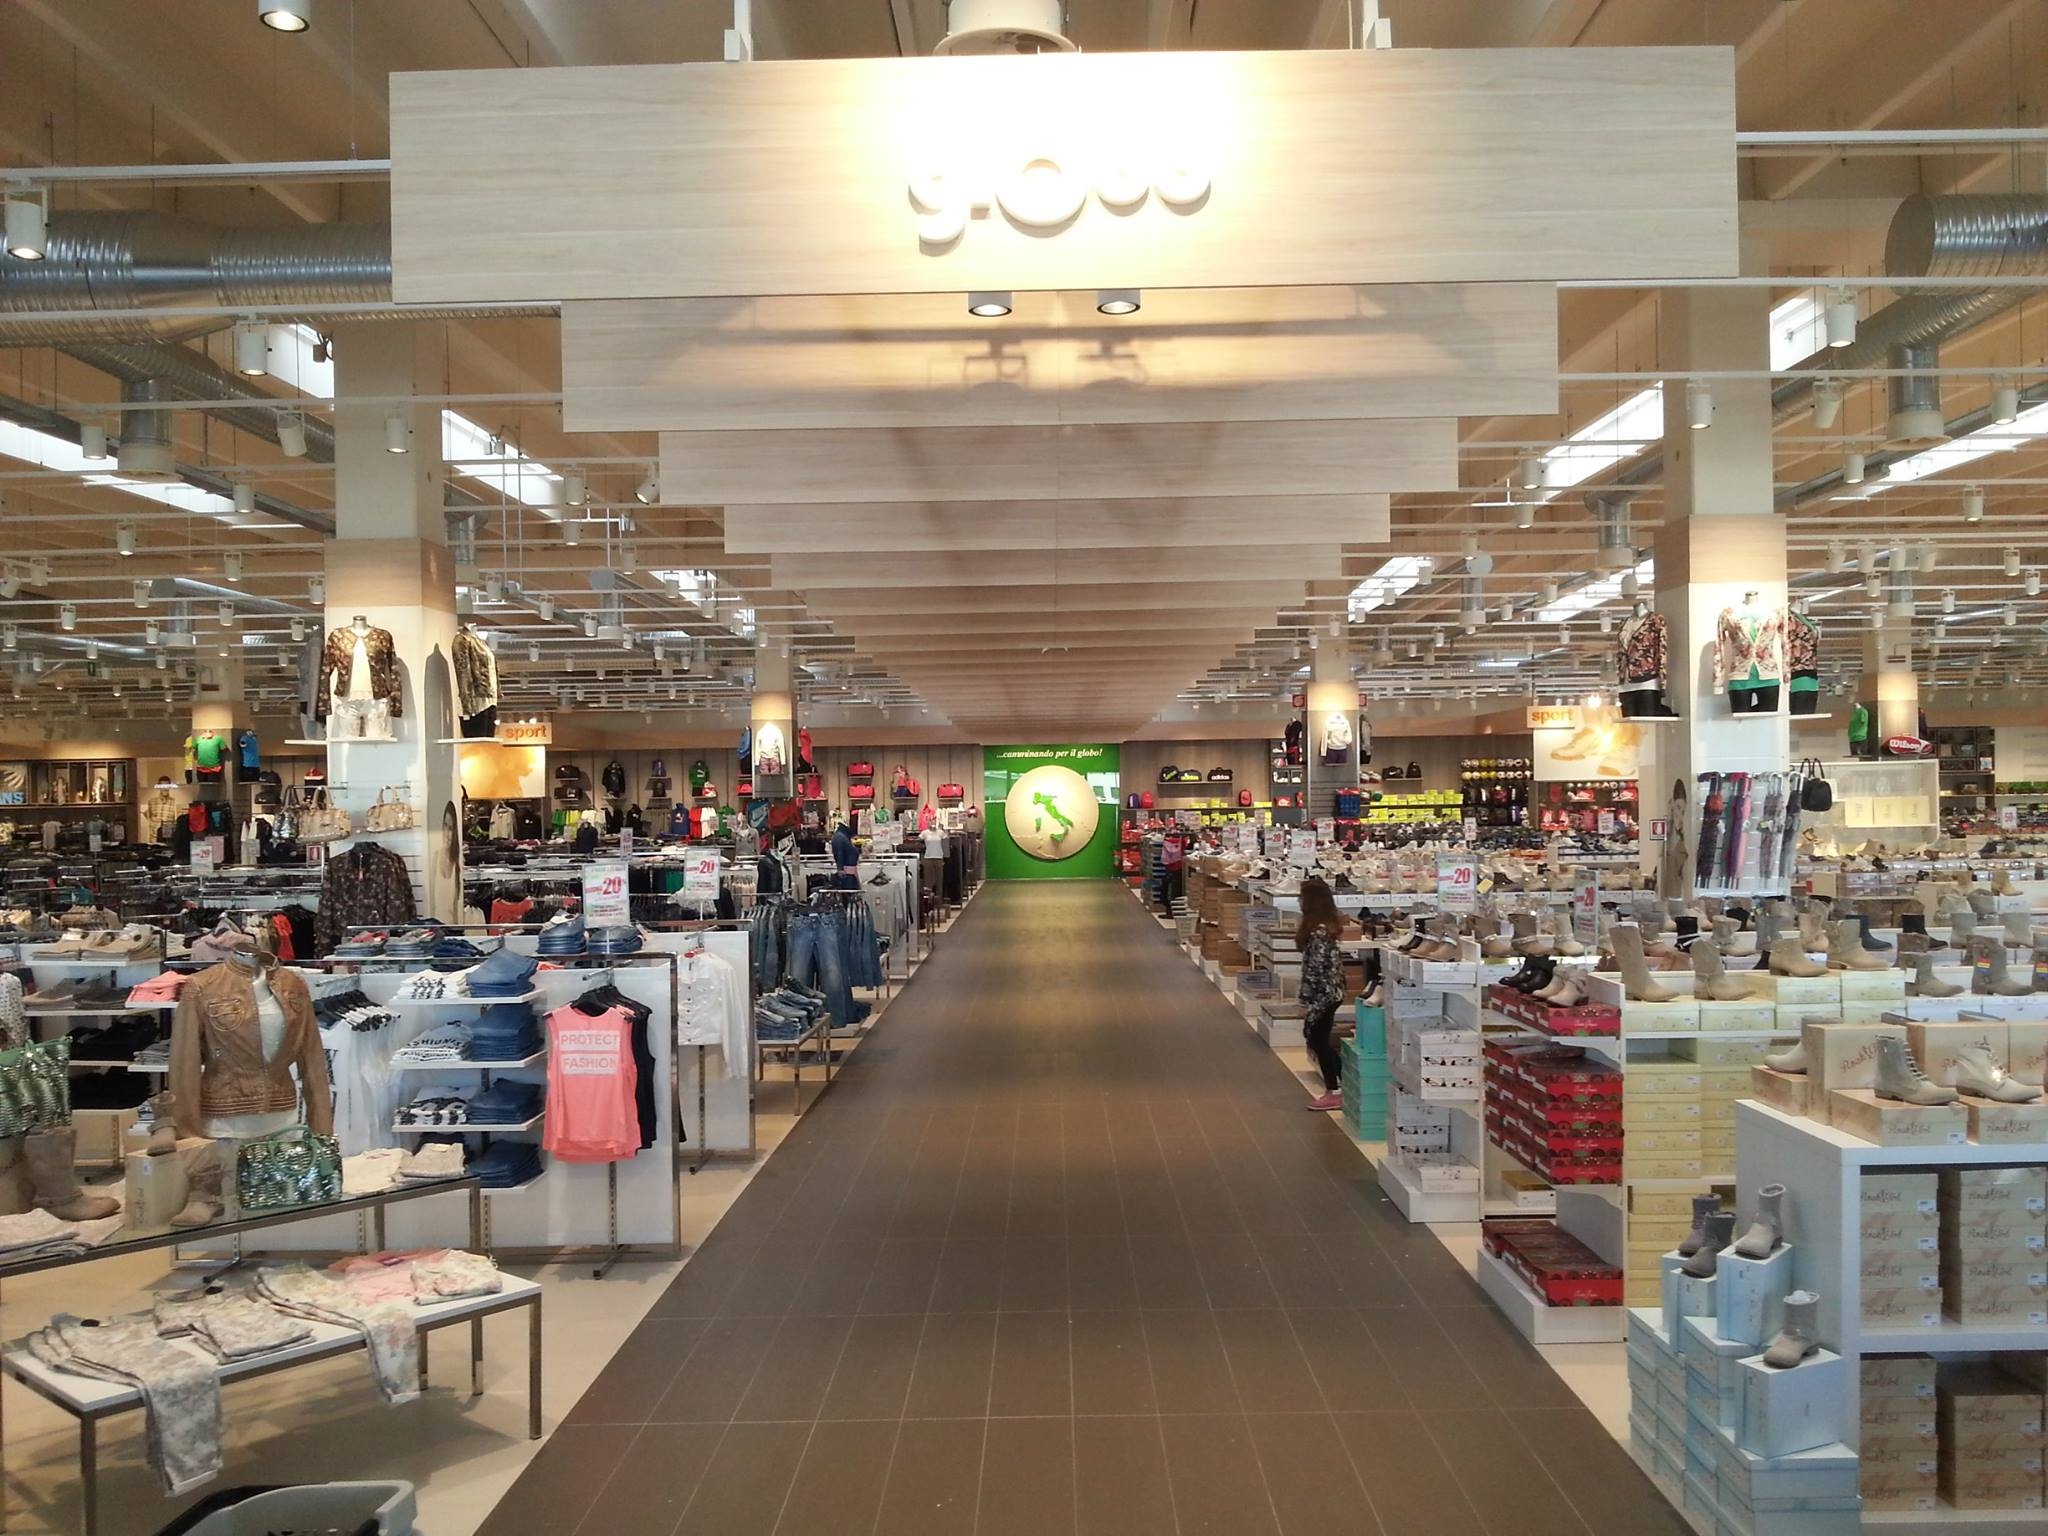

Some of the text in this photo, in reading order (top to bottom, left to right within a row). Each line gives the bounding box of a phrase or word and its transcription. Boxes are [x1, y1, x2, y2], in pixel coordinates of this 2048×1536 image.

[1531, 708, 1574, 725] sport
[505, 725, 547, 742] sport
[1054, 750, 1069, 760] per
[1070, 748, 1077, 757] il
[1077, 748, 1103, 759] globo!
[561, 1034, 619, 1045] PROTECT
[563, 1057, 616, 1068] FASHION
